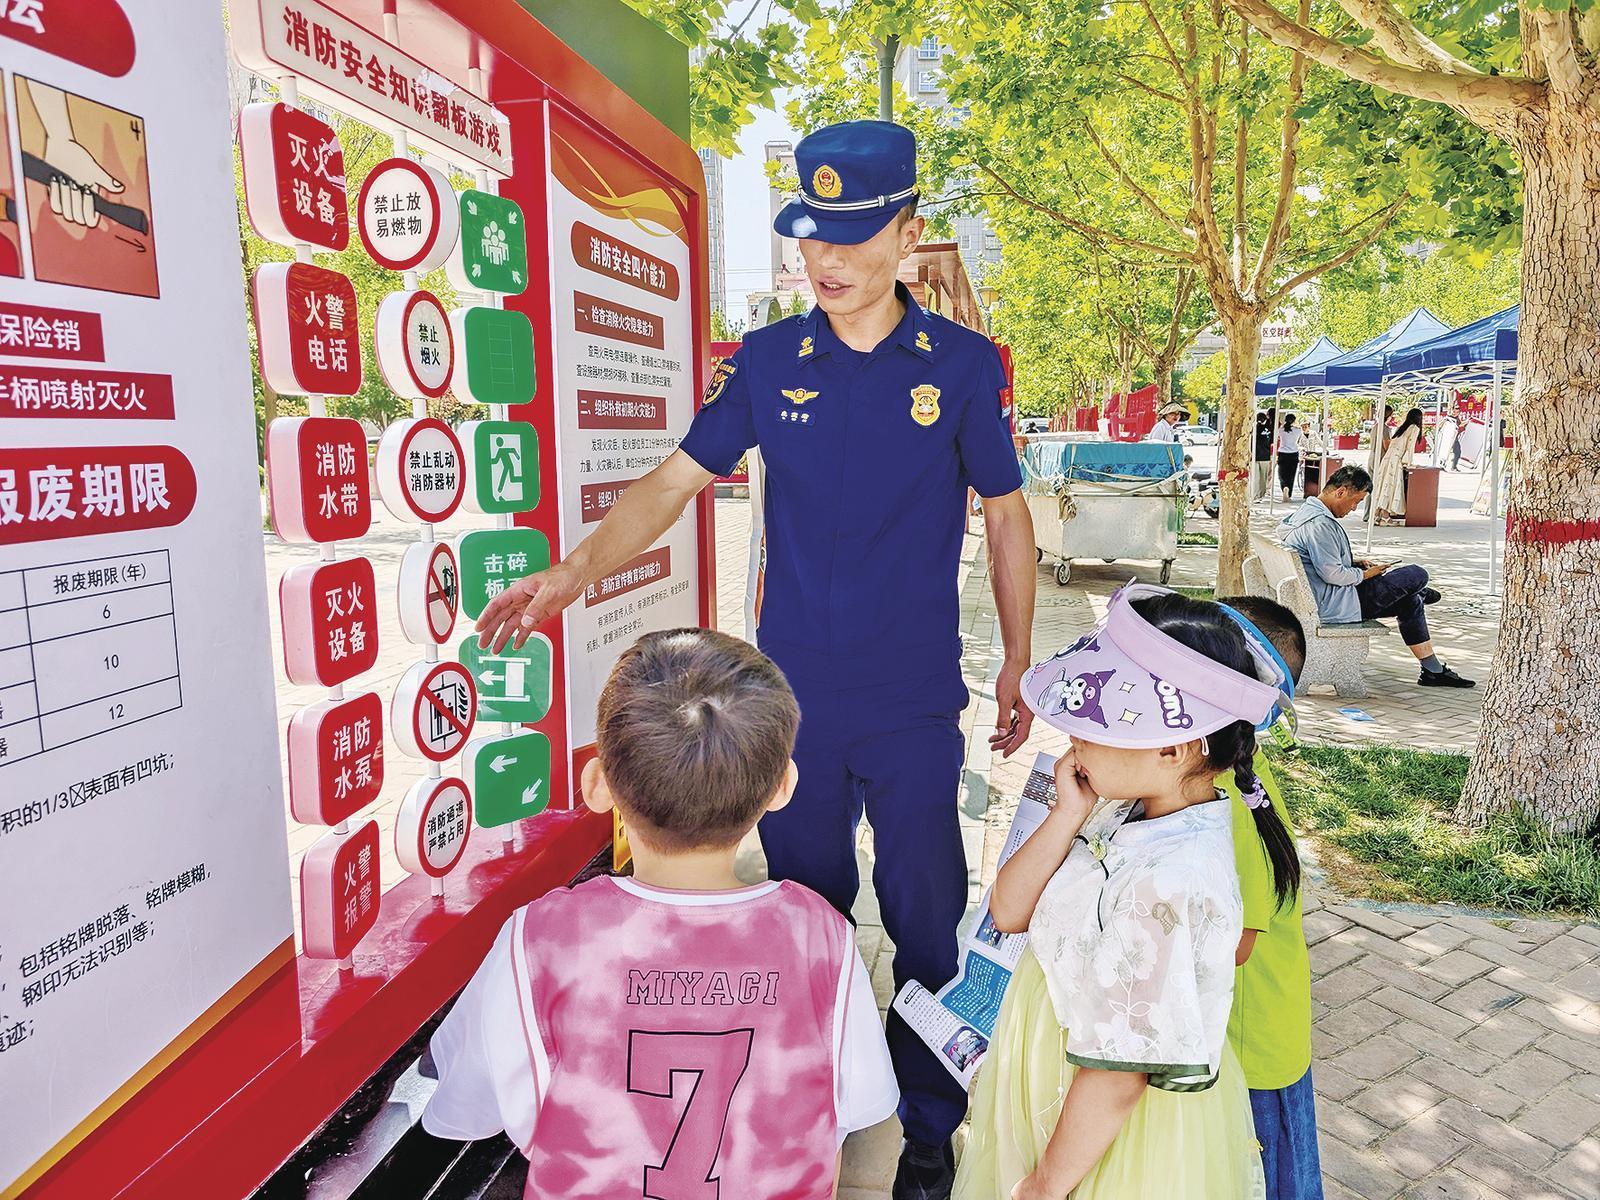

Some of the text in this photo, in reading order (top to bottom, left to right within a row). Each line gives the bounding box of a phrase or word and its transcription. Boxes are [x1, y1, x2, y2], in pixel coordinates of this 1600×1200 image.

[283, 6, 502, 157] 消防安全知识翻板游戏
[287, 131, 334, 181] 灭火
[292, 178, 336, 227] 设备
[374, 192, 422, 215] 禁止放
[376, 216, 423, 238] 易燃物
[589, 236, 666, 290] 消防安全四个能力
[304, 291, 345, 332] 火警
[418, 323, 440, 344] 禁止
[308, 334, 348, 373] 电话
[420, 346, 441, 367] 烟火
[316, 443, 356, 478] 消防
[409, 450, 455, 470] 禁止乱动
[411, 472, 456, 492] 消防器材
[318, 483, 359, 519] 水带
[484, 552, 528, 574] 击碎
[325, 581, 364, 623] 灭火
[485, 577, 523, 600] 板
[102, 605, 111, 620] 6
[328, 621, 367, 663] 设备
[103, 654, 120, 670] 10
[108, 703, 125, 721] 12
[1155, 679, 1193, 729] omi
[332, 715, 371, 762] 消防
[334, 753, 373, 800] 水泵
[427, 799, 464, 836] 消防通道
[428, 822, 464, 857] 严禁占用
[344, 843, 371, 897] 火警
[344, 880, 372, 934] 报警
[626, 1027, 755, 1200] 7
